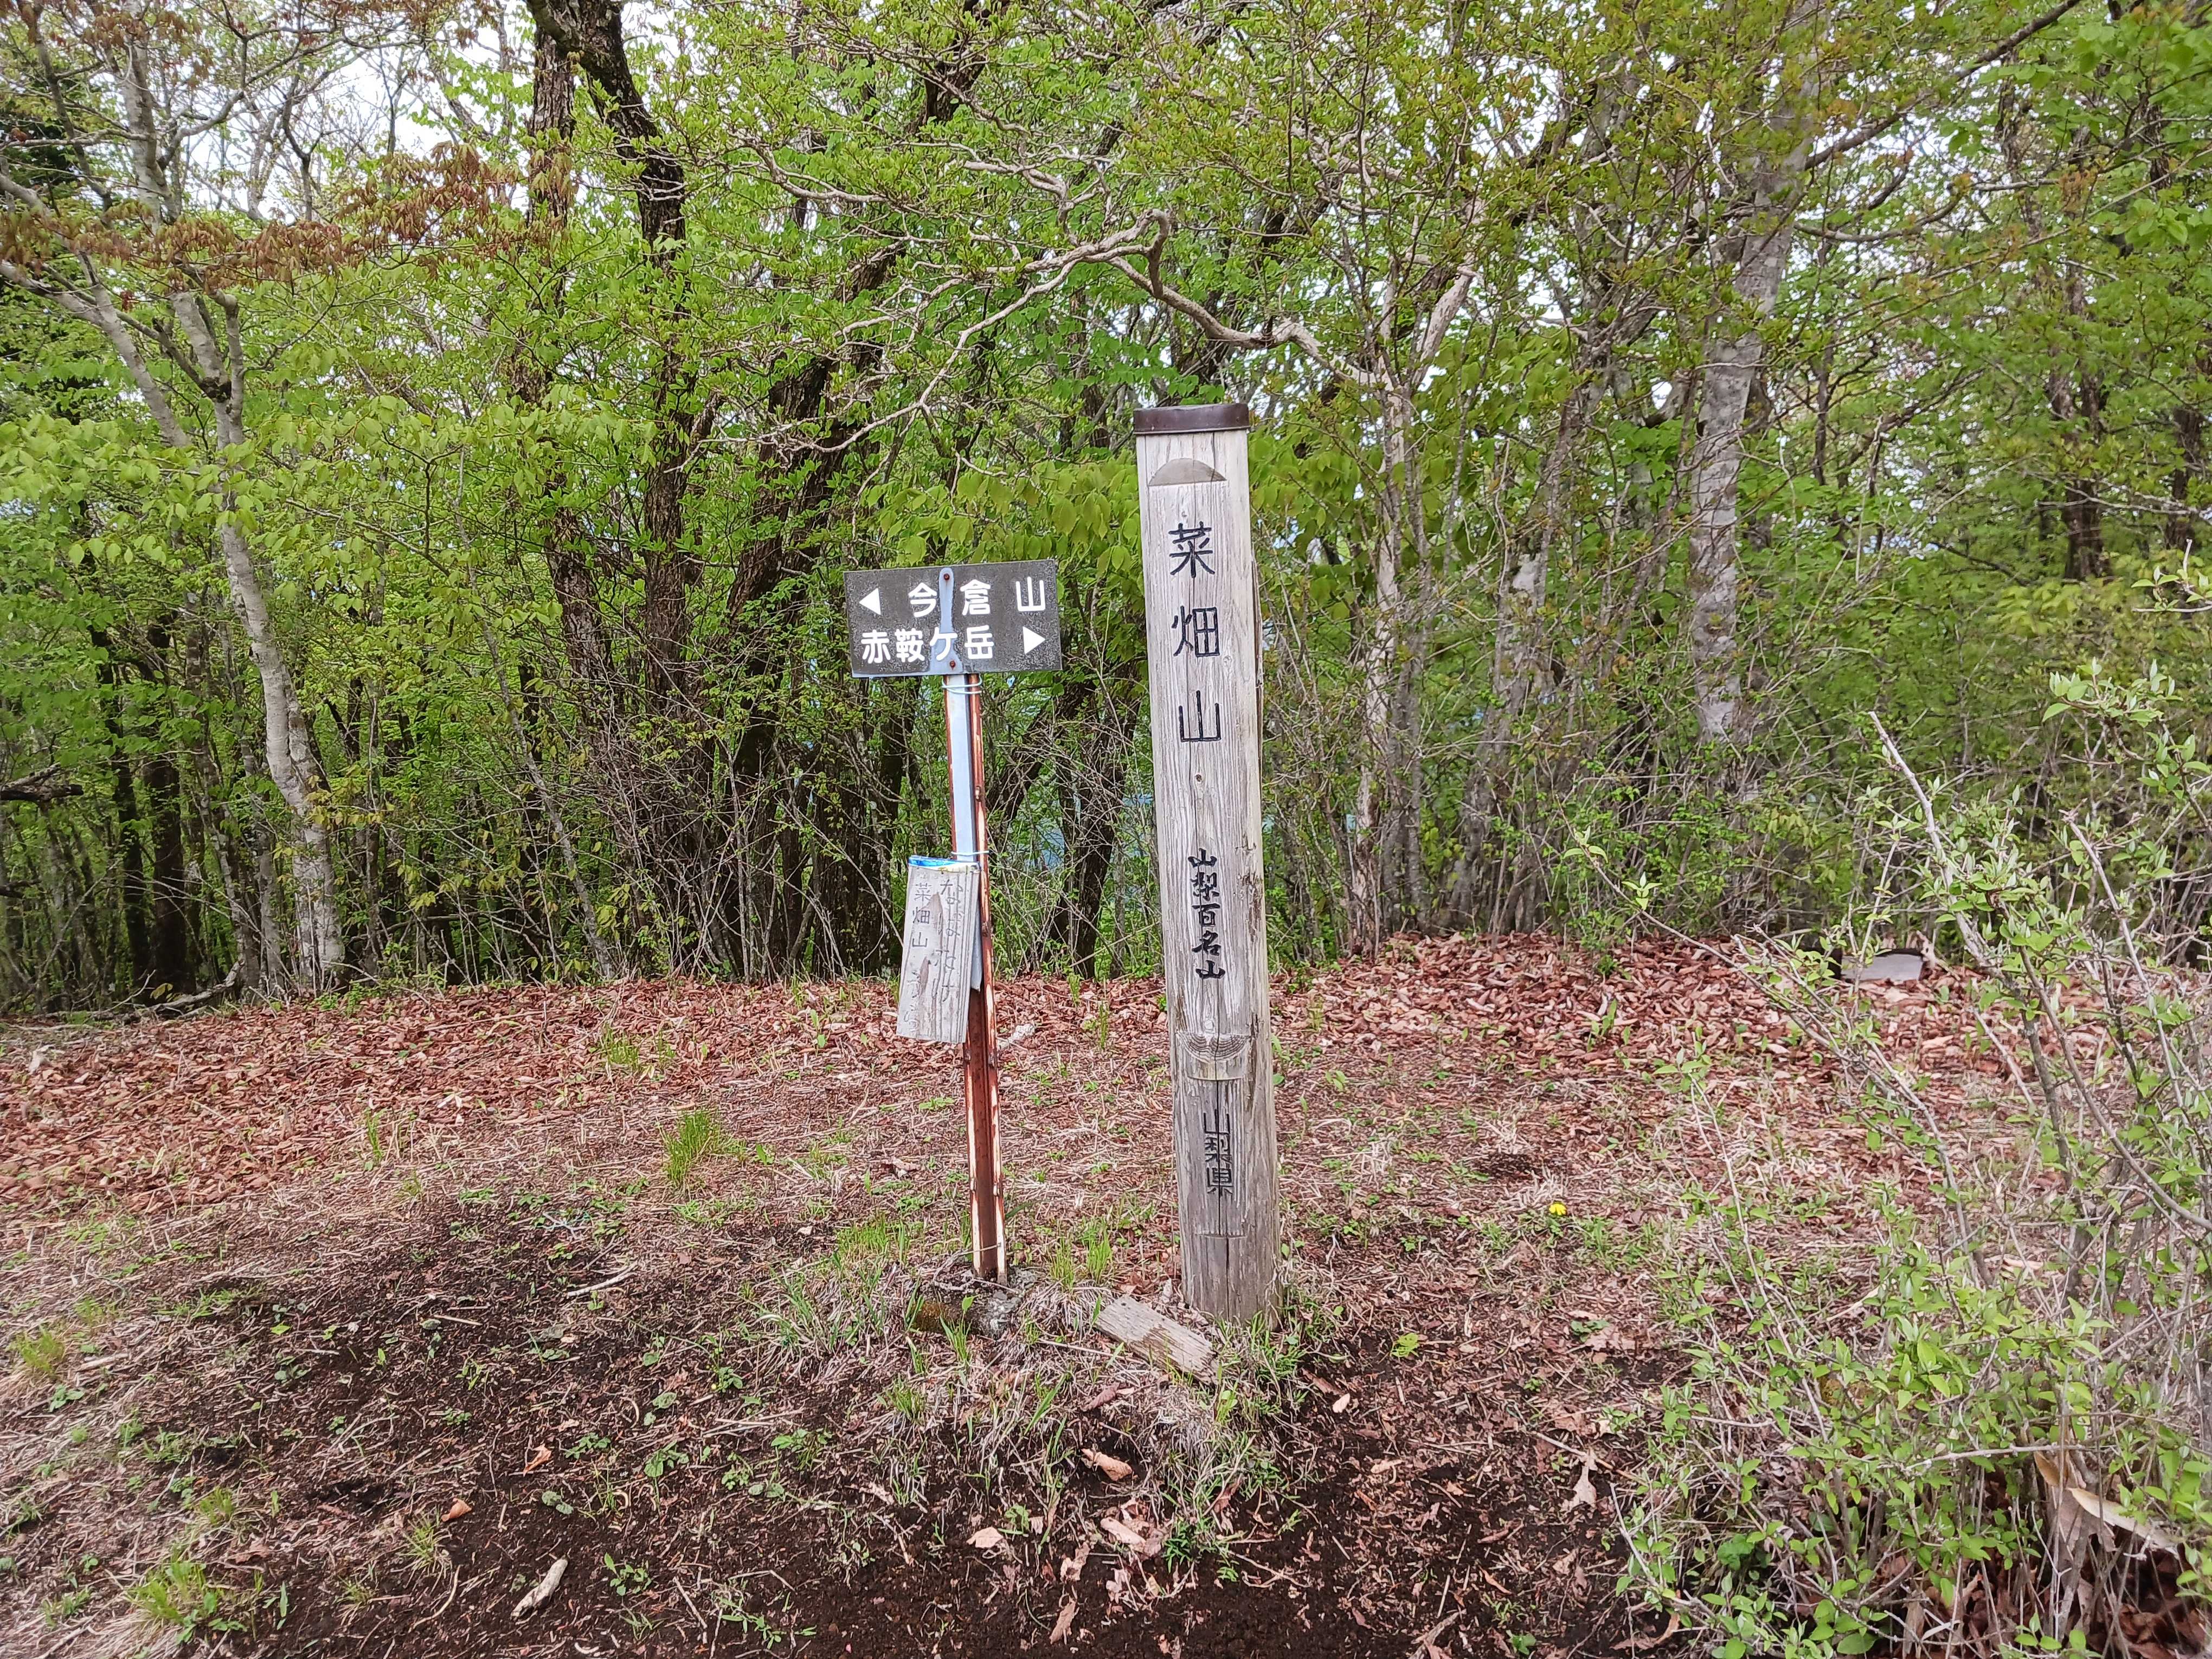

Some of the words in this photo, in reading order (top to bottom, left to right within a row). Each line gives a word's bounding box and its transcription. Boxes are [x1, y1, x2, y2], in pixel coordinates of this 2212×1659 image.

[908, 576, 1046, 618] 今倉山
[1168, 521, 1221, 742] 菜畑山
[911, 882, 933, 949] 菜畑山
[1187, 847, 1226, 980] 山梨百名山
[1203, 1108, 1234, 1197] 山梨県
